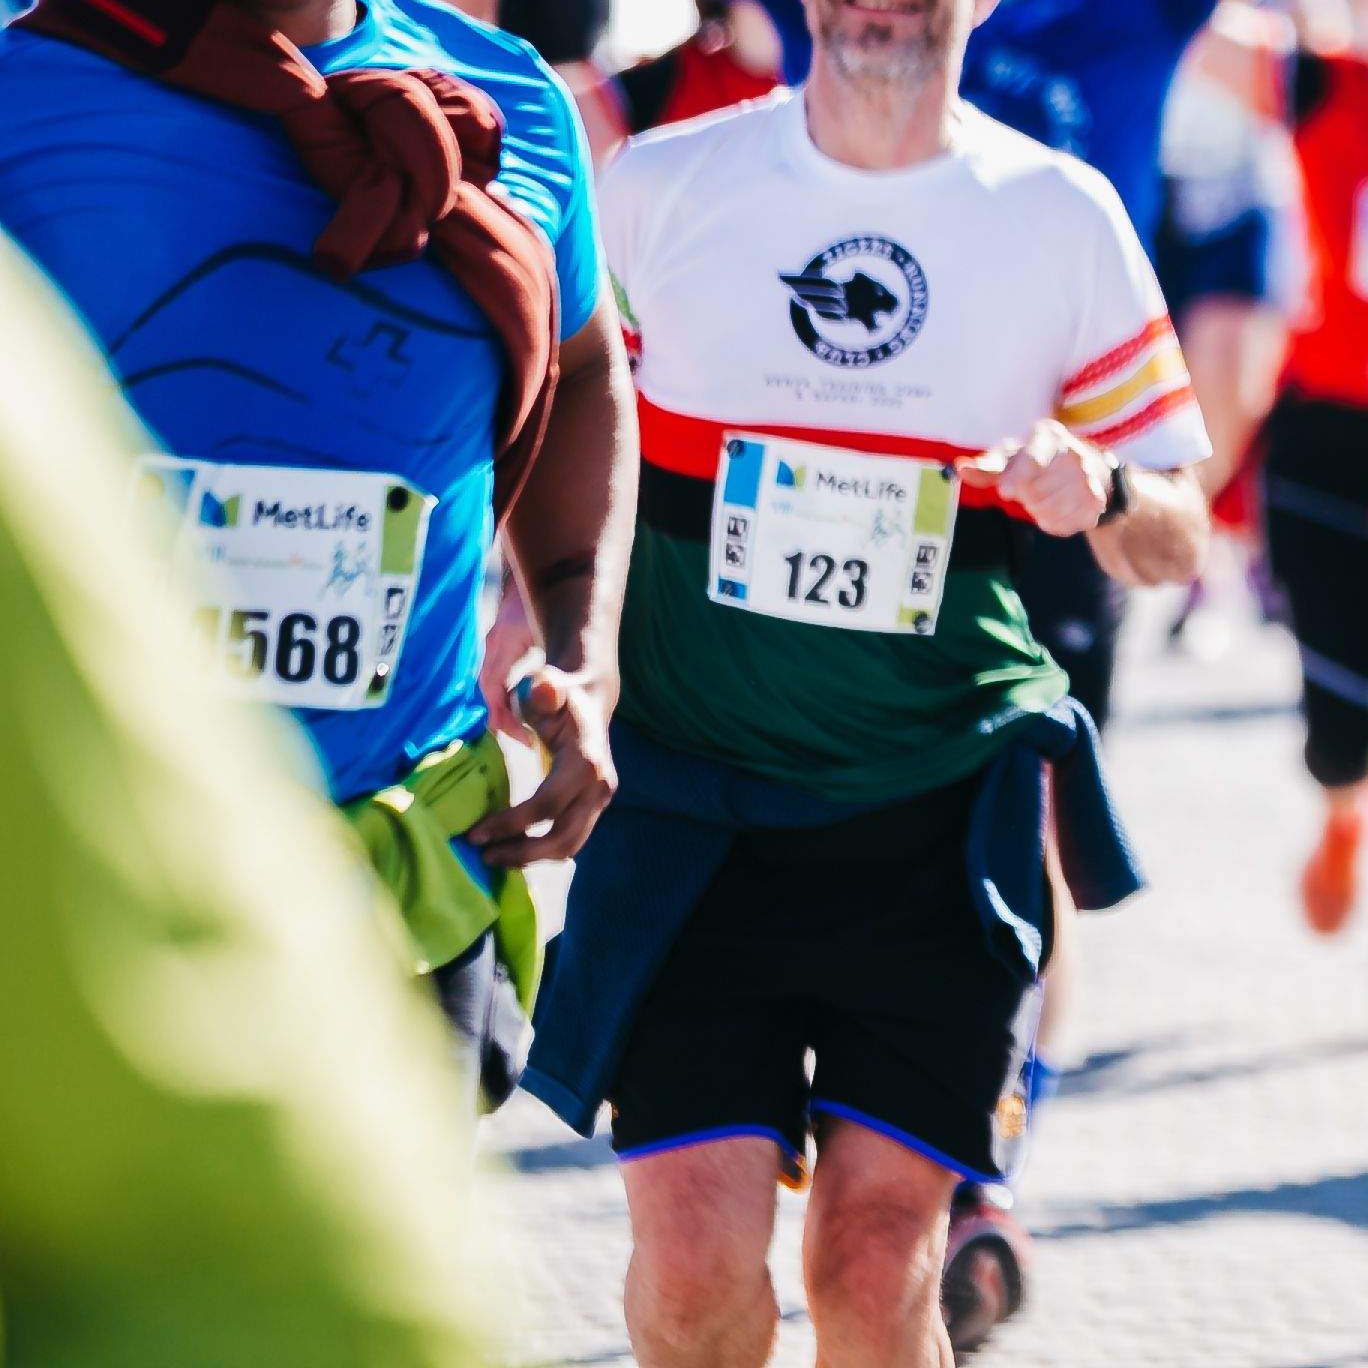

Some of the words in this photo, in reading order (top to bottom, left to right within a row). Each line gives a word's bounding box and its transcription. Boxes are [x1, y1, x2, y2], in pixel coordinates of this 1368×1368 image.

[816, 471, 907, 503] MetLife
[253, 500, 370, 532] MetLife
[785, 551, 869, 609] 123
[197, 606, 361, 685] 568
